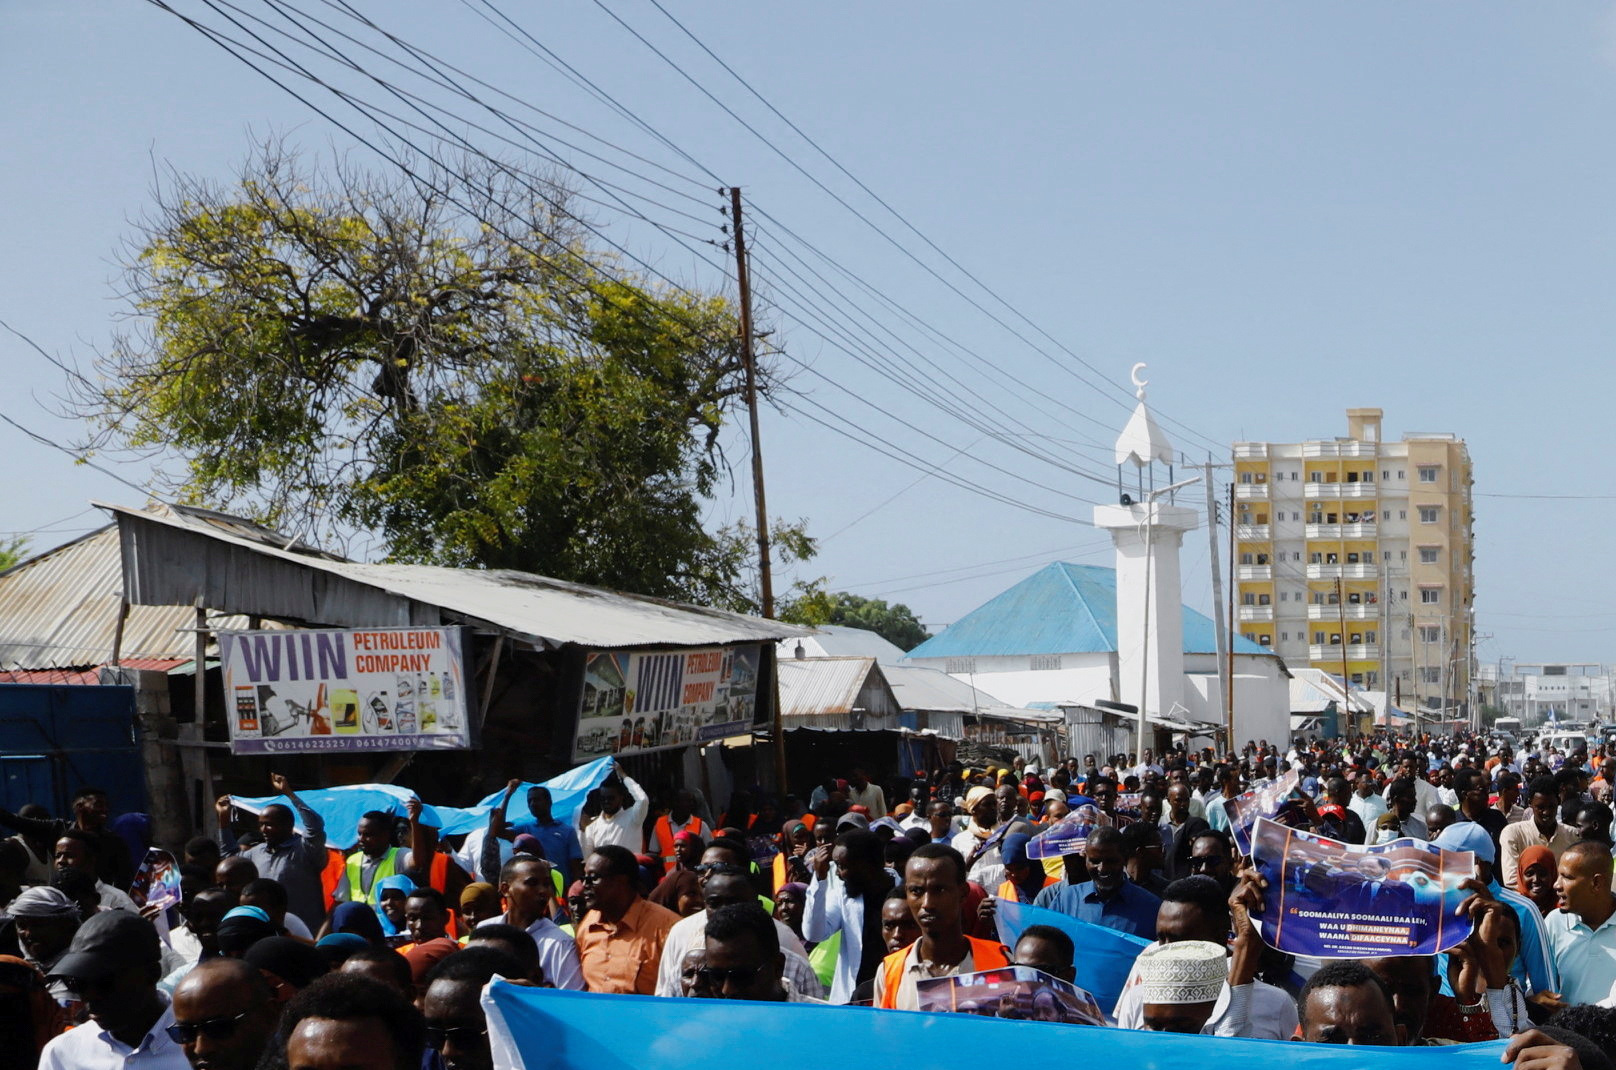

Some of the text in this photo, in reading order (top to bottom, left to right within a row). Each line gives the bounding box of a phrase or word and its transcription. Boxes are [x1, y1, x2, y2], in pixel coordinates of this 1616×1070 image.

[354, 631, 440, 650] PETROLEUM
[239, 633, 347, 682] WIIN
[356, 653, 432, 673] COMPANY
[635, 654, 685, 713] WIIN
[1298, 911, 1428, 926] SOOMAALIYA SOOMAALI BAA LEH,
[1319, 933, 1350, 941] WAANA
